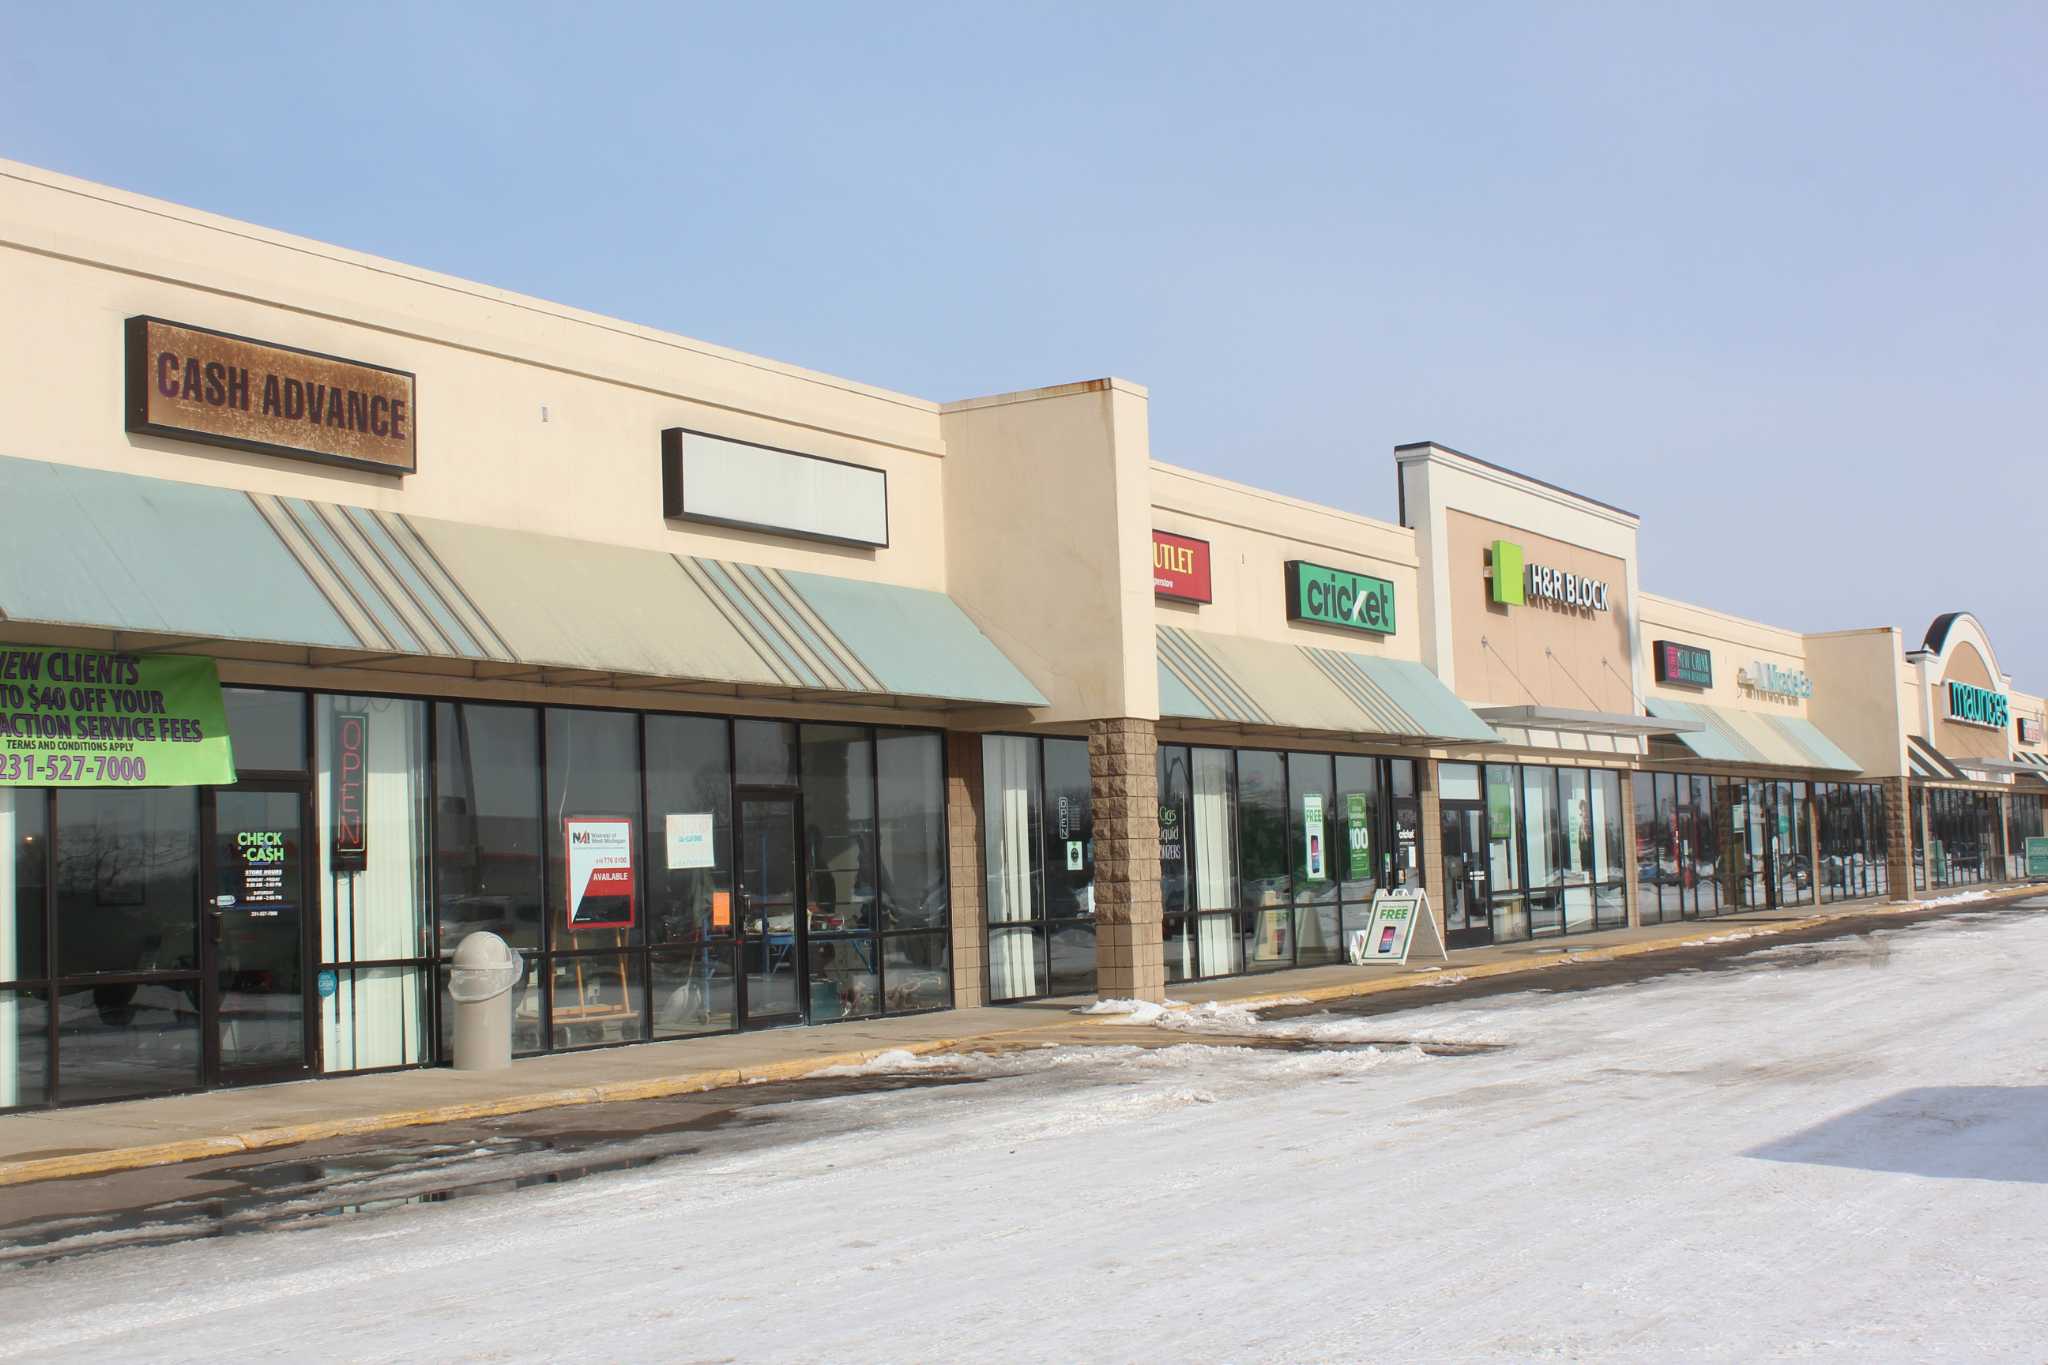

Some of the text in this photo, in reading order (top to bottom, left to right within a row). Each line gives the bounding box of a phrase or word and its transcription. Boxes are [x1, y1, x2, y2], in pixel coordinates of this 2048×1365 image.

[157, 351, 406, 440] CASH ADVANCE
[1153, 541, 1194, 575] UTLET
[1307, 574, 1389, 627] cricket
[1530, 563, 1609, 612] H&R BLOCK
[47, 653, 141, 685] CLIENTS
[0, 683, 167, 714] TO $40 OFF YOUR
[1950, 681, 2010, 728] maurices
[77, 715, 156, 741] SERVICE
[158, 718, 204, 742] FEES
[7, 739, 134, 752] TERMS AND CONDITIONS APPLY
[0, 753, 147, 781] 231-527-7000
[341, 719, 362, 845] OPEN
[1306, 808, 1322, 823] FREE
[237, 832, 282, 846] CHECK
[572, 831, 590, 844] NAI
[593, 872, 628, 881] AVAILABLE
[1380, 908, 1408, 919] FREE
